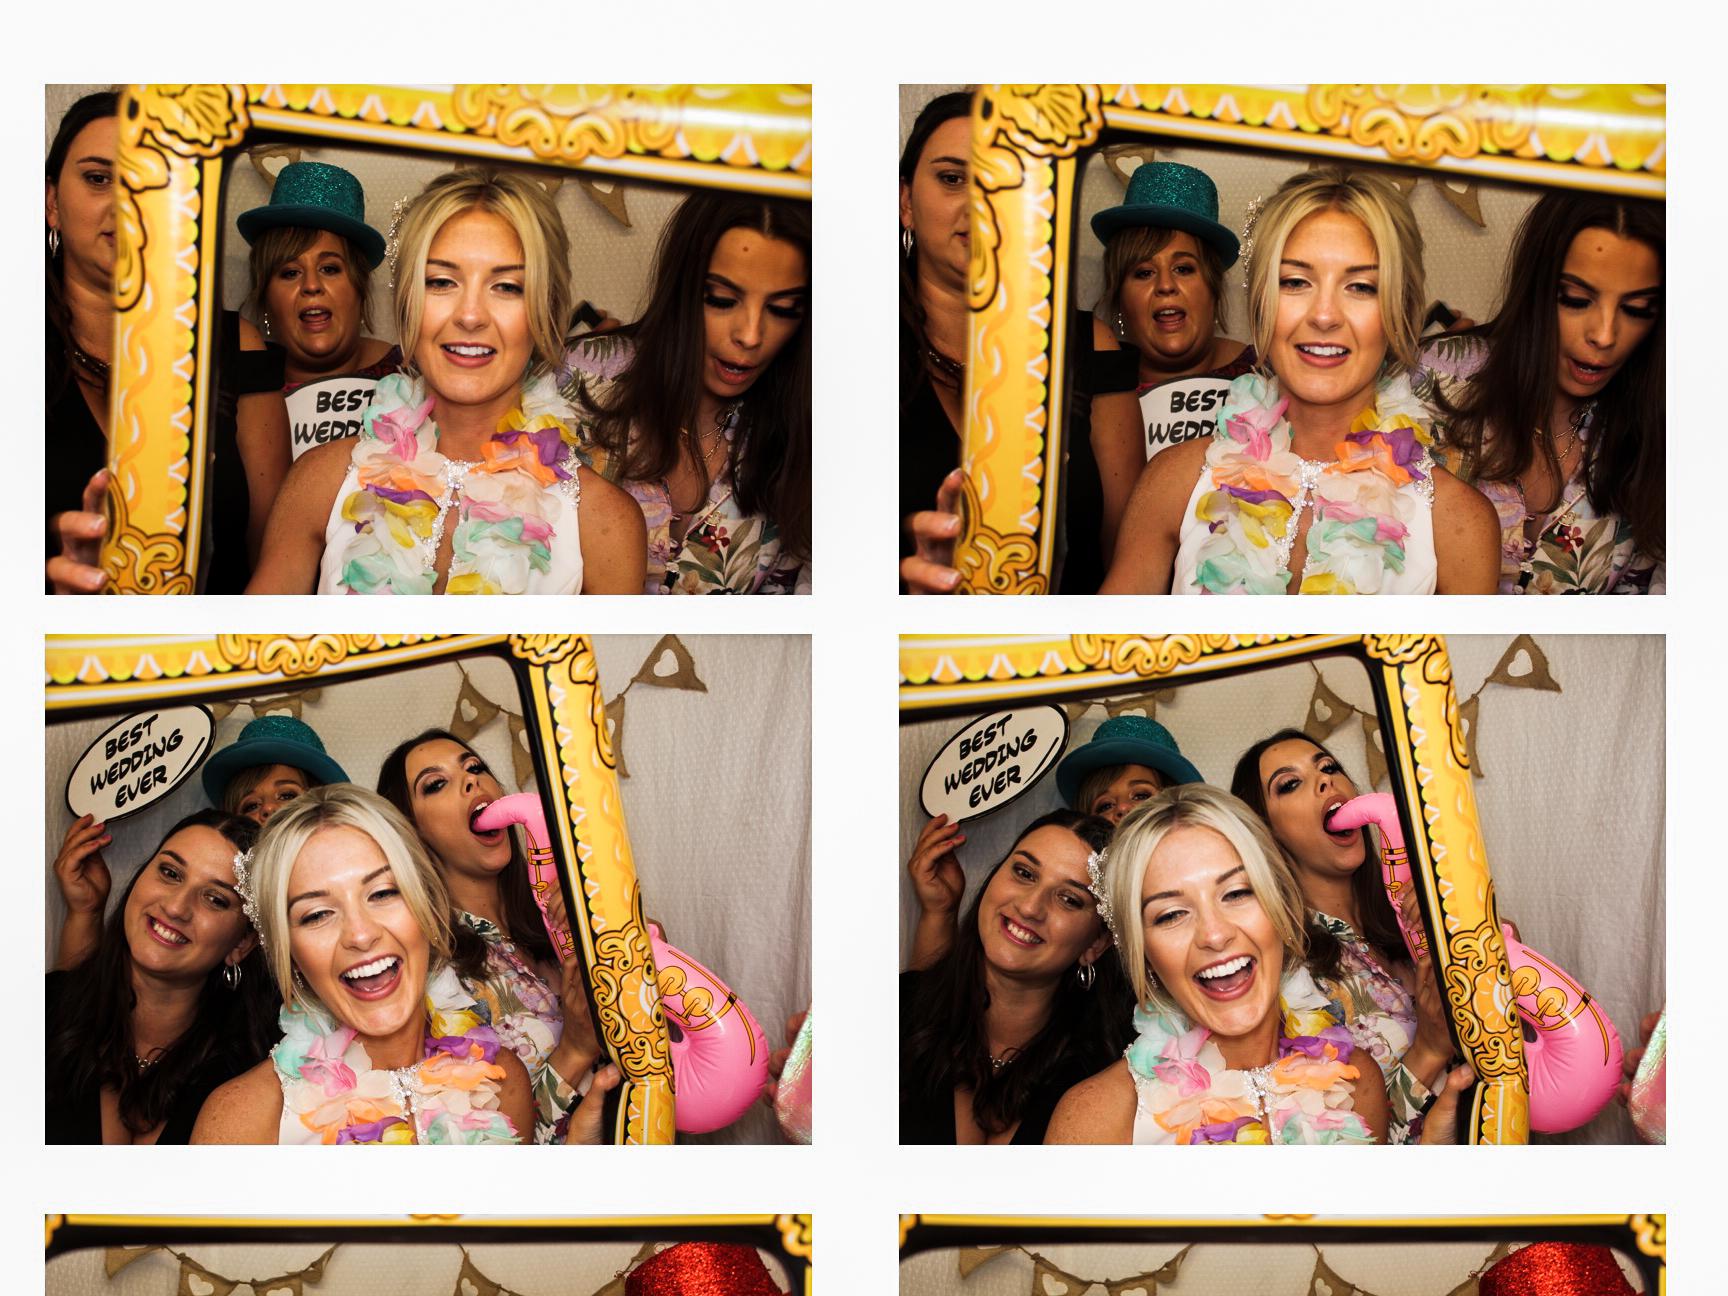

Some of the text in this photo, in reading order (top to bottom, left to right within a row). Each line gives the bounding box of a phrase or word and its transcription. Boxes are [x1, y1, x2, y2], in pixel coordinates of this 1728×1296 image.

[316, 389, 375, 413] BEST
[1170, 389, 1229, 413] BEST
[294, 420, 365, 445] WEDD
[1148, 420, 1219, 445] WEDD
[105, 713, 159, 760] BEST
[959, 713, 1013, 760] BEST
[90, 728, 184, 795] WEDDING
[944, 728, 1038, 795] WEDDING
[115, 765, 167, 808] EVER
[969, 765, 1021, 808] EVER
